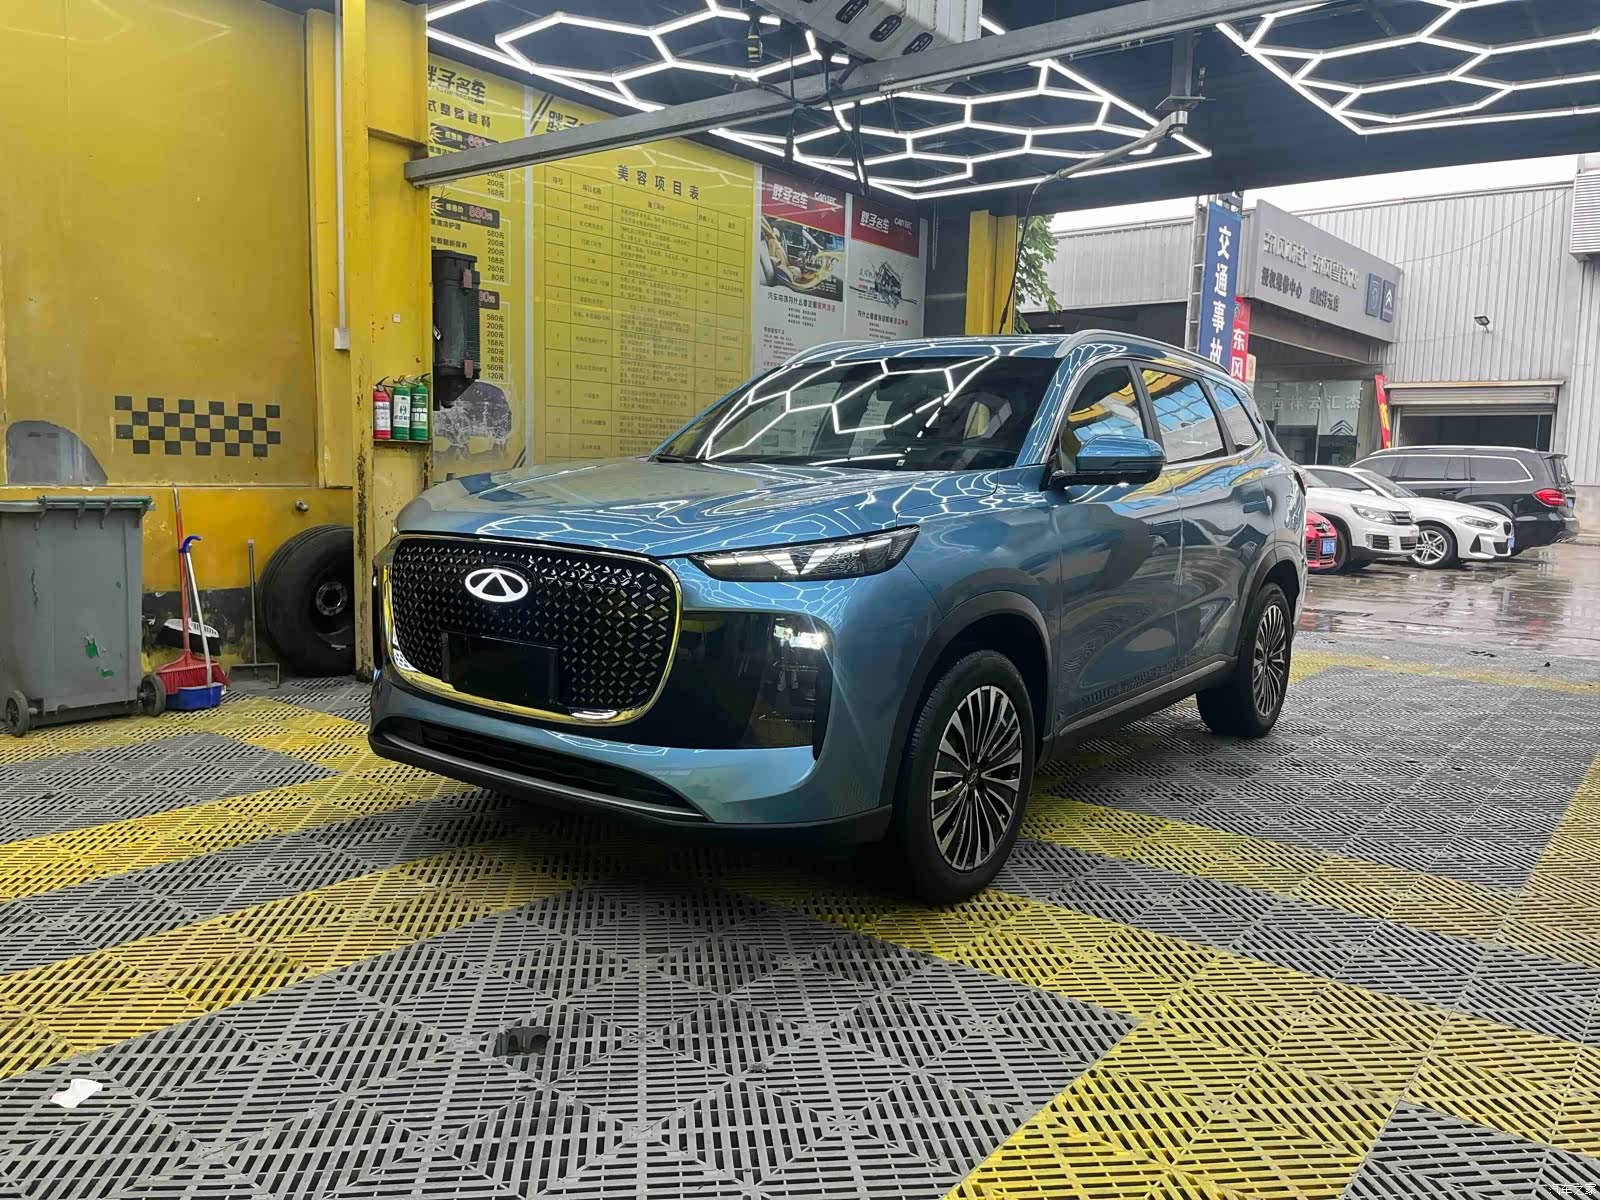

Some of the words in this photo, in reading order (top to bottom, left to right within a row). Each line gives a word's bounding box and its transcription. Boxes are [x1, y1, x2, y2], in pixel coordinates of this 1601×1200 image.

[549, 110, 585, 132] 胖子
[617, 163, 700, 201] 美容项目表
[772, 183, 809, 206] 胖子名车
[860, 210, 890, 230] 胖子名车
[487, 230, 504, 239] 580元
[487, 238, 504, 248] 200元
[487, 247, 504, 257] 200元
[1263, 230, 1309, 269] 东风标致
[1311, 253, 1360, 291] 东风雪铁龙
[1209, 225, 1232, 365] 交通事故
[486, 314, 504, 322] 580元
[486, 322, 504, 330] 200元
[486, 331, 504, 339] 200元
[487, 339, 504, 347] 168元
[487, 348, 504, 356] 260元
[1230, 327, 1246, 380] 东风
